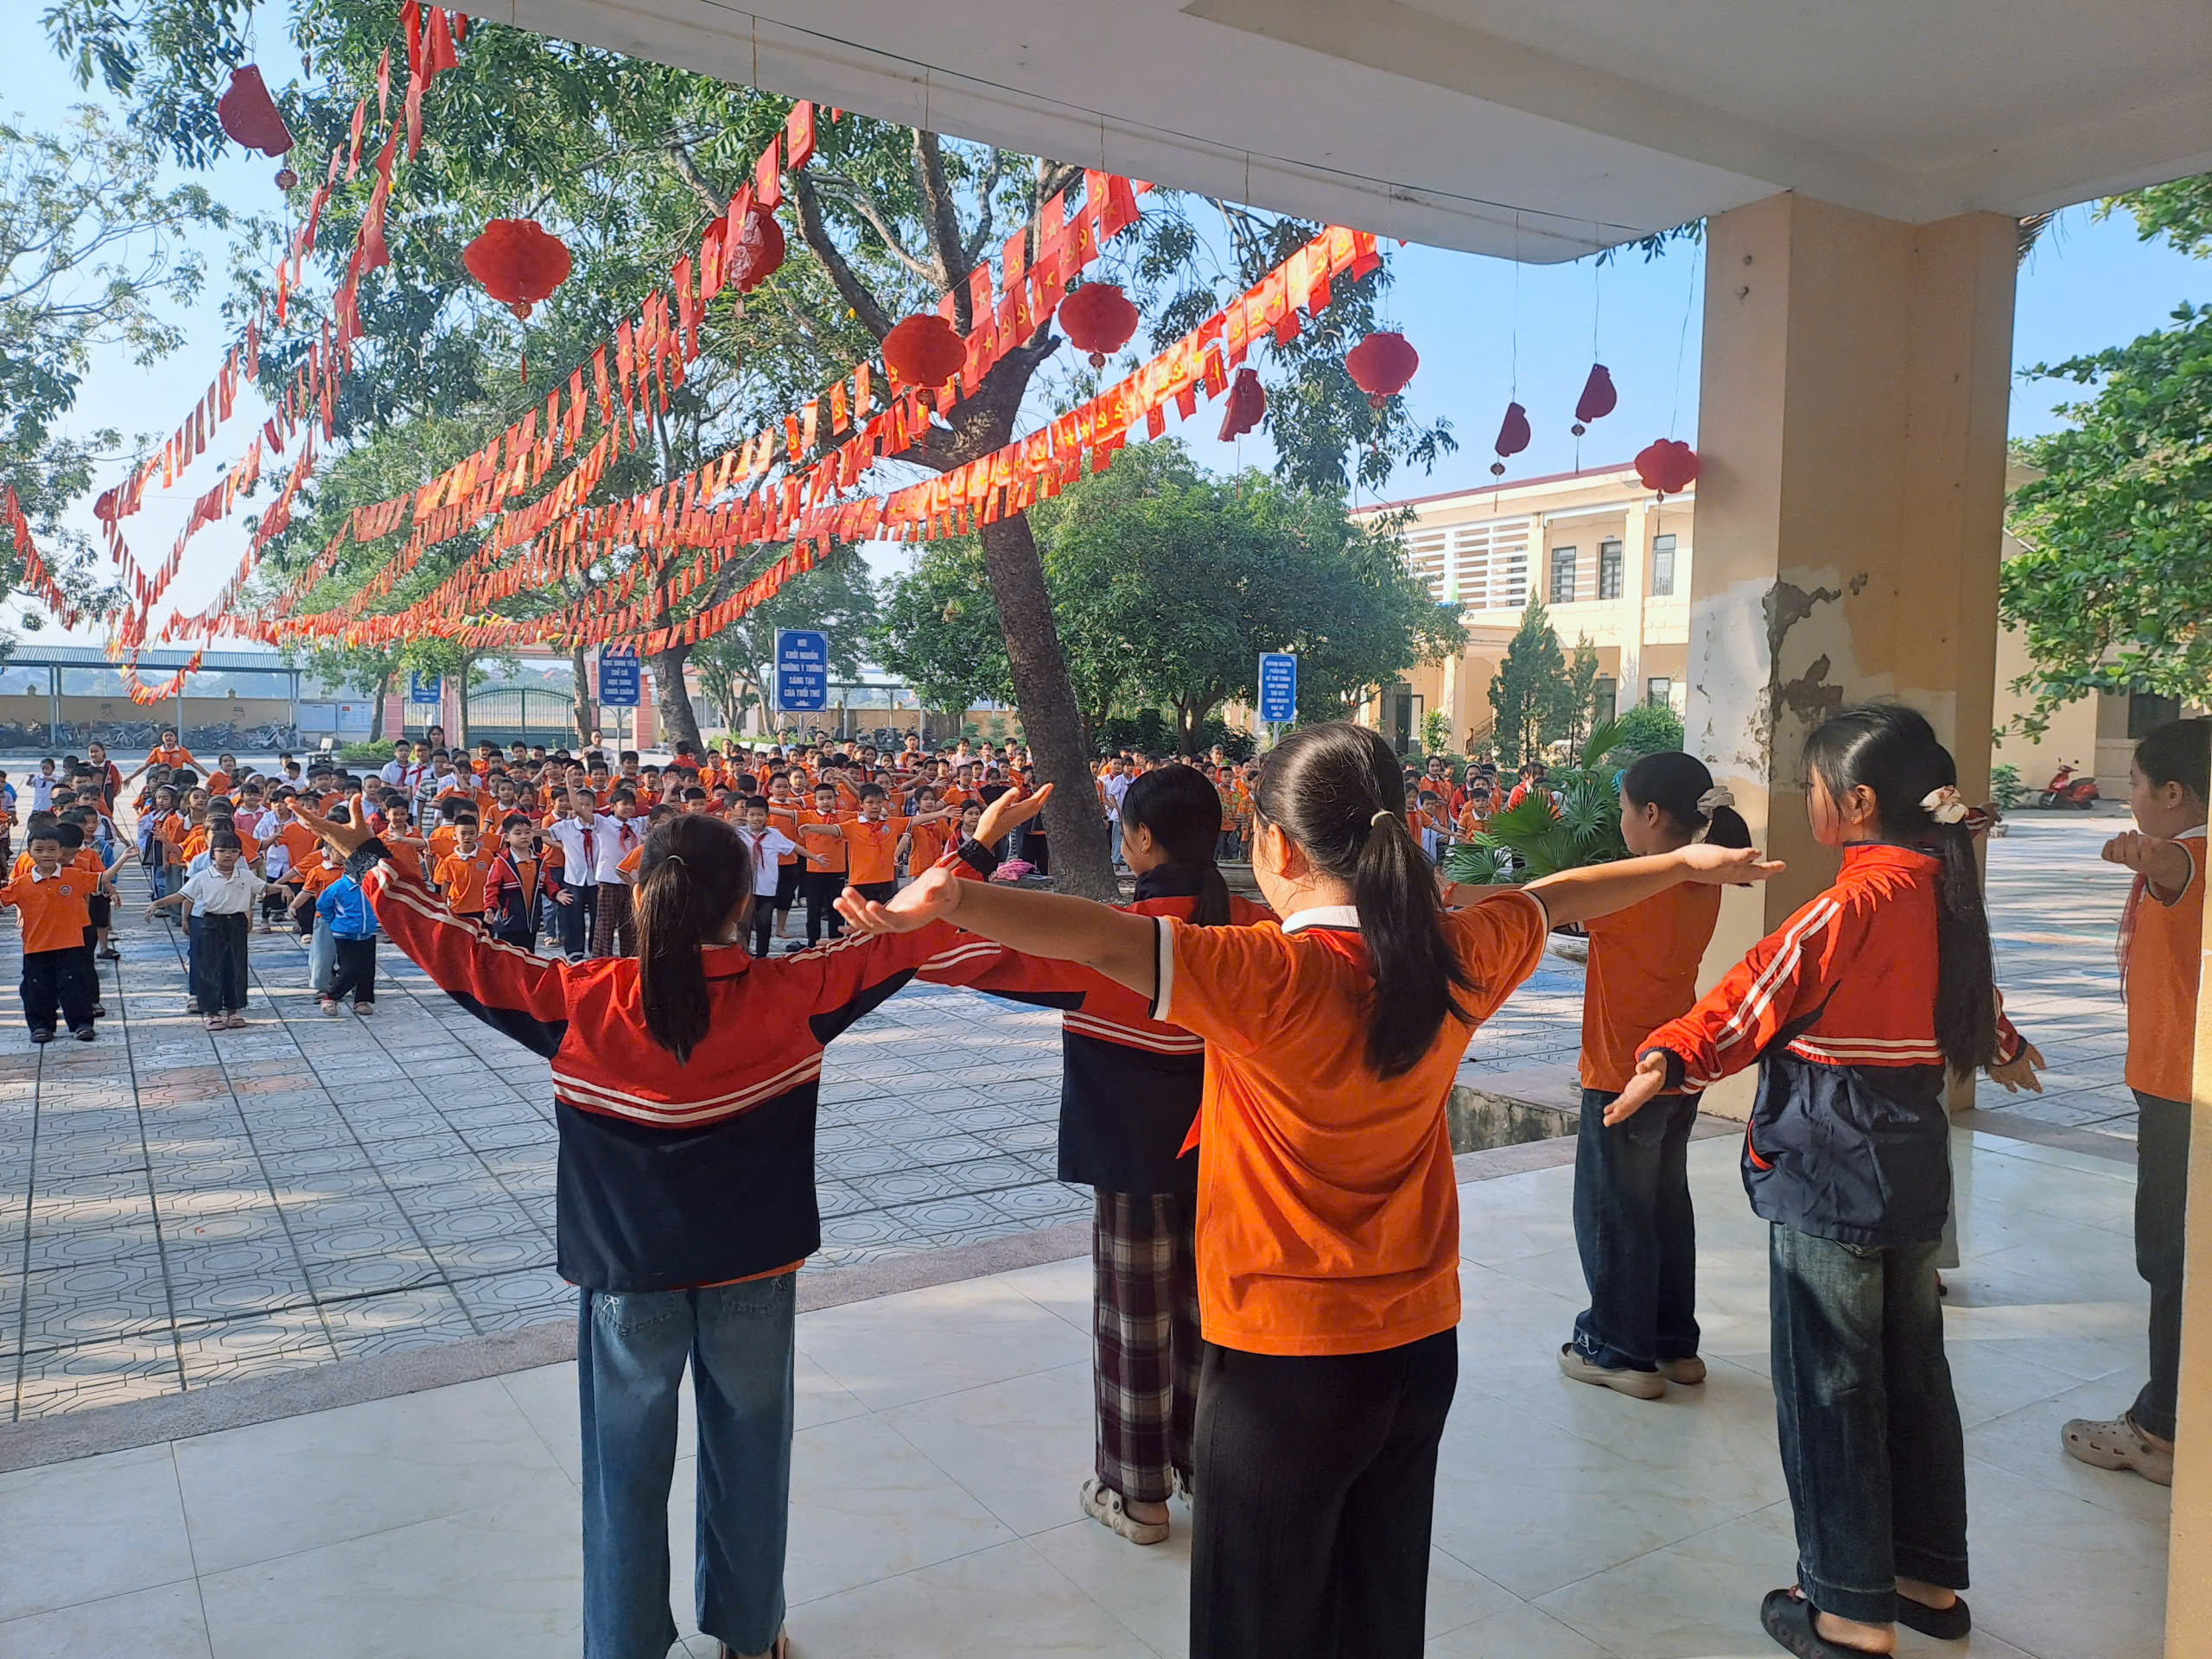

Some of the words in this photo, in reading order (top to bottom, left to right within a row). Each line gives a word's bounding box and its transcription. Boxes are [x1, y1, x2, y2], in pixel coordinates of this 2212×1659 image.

[785, 649, 798, 659] KHỞI
[799, 649, 819, 659] NGUỒN
[788, 675, 804, 684] SÁNG
[804, 677, 815, 686] TẠO
[784, 686, 795, 697] CỦA
[796, 686, 808, 697] TUỔI
[809, 689, 820, 697] THƠ
